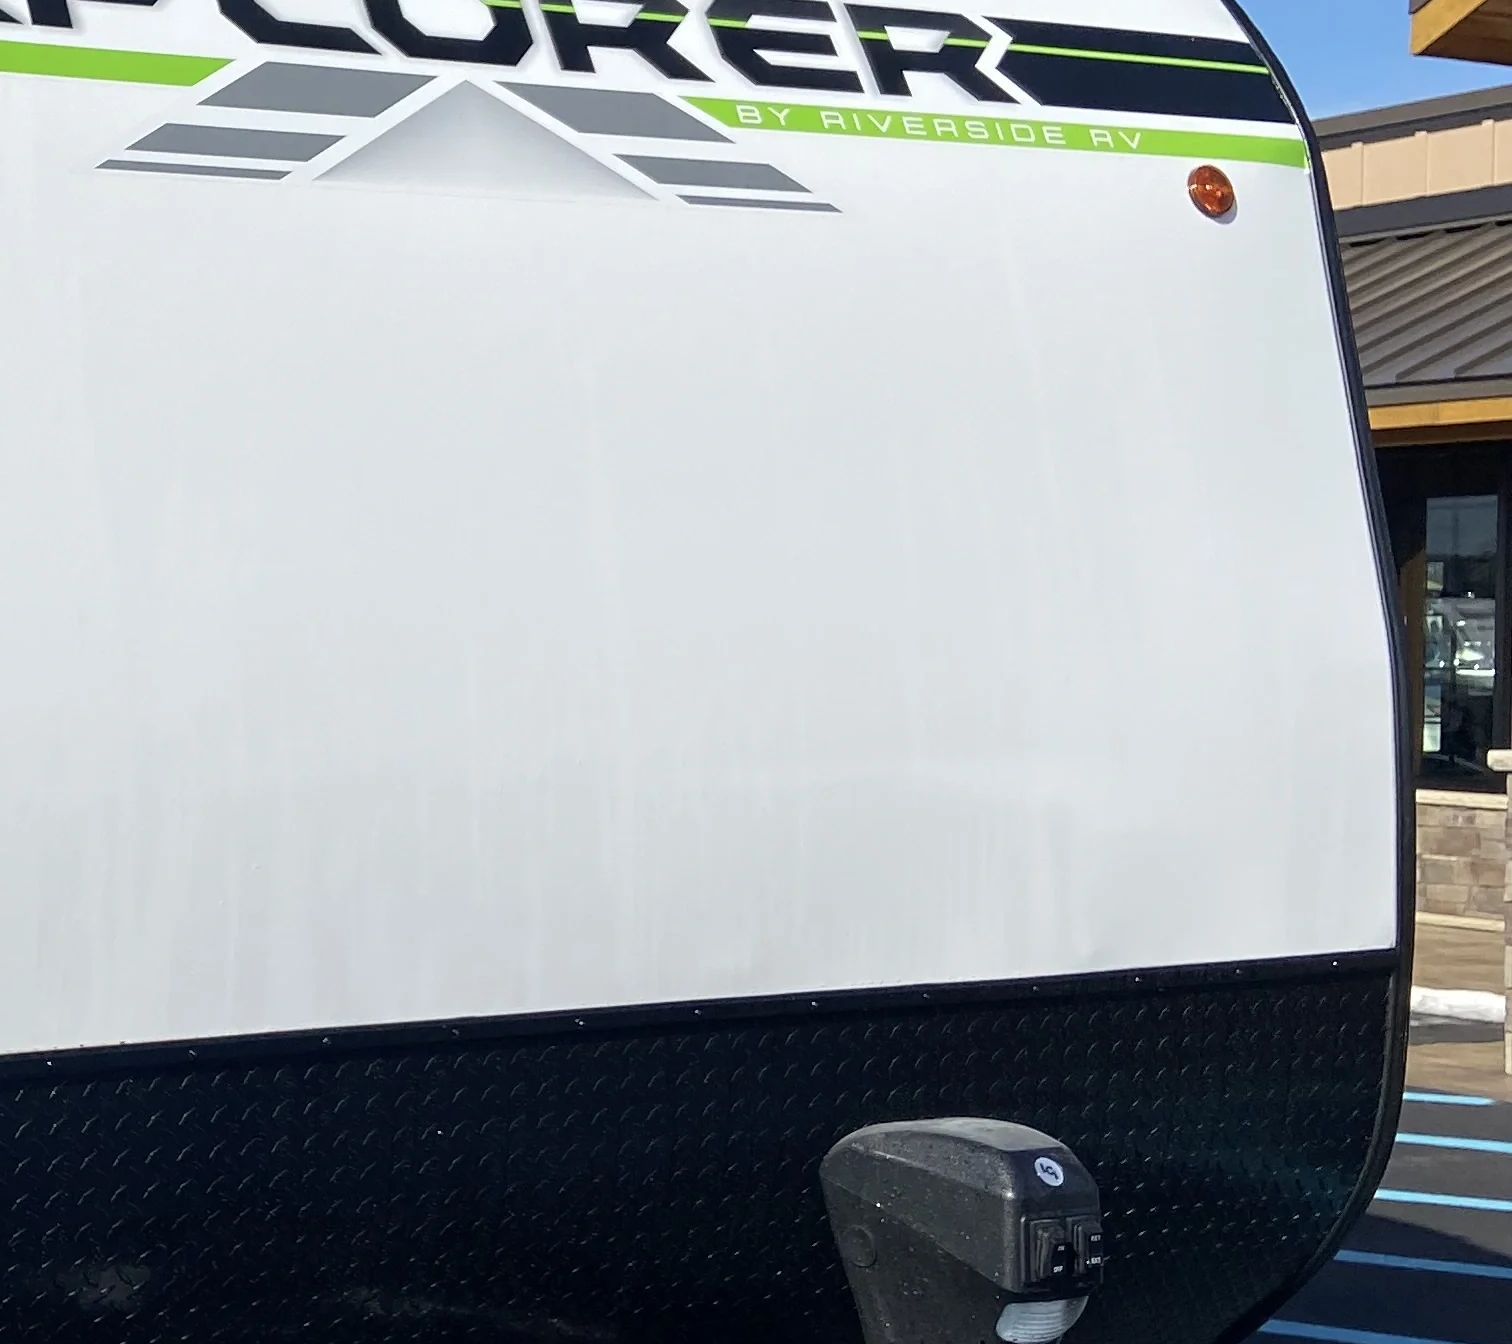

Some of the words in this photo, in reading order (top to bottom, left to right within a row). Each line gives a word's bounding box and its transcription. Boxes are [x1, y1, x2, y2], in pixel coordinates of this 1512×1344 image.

[735, 104, 791, 126] BY
[819, 110, 1067, 145] RIVERSIDE
[1090, 128, 1141, 150] RV
